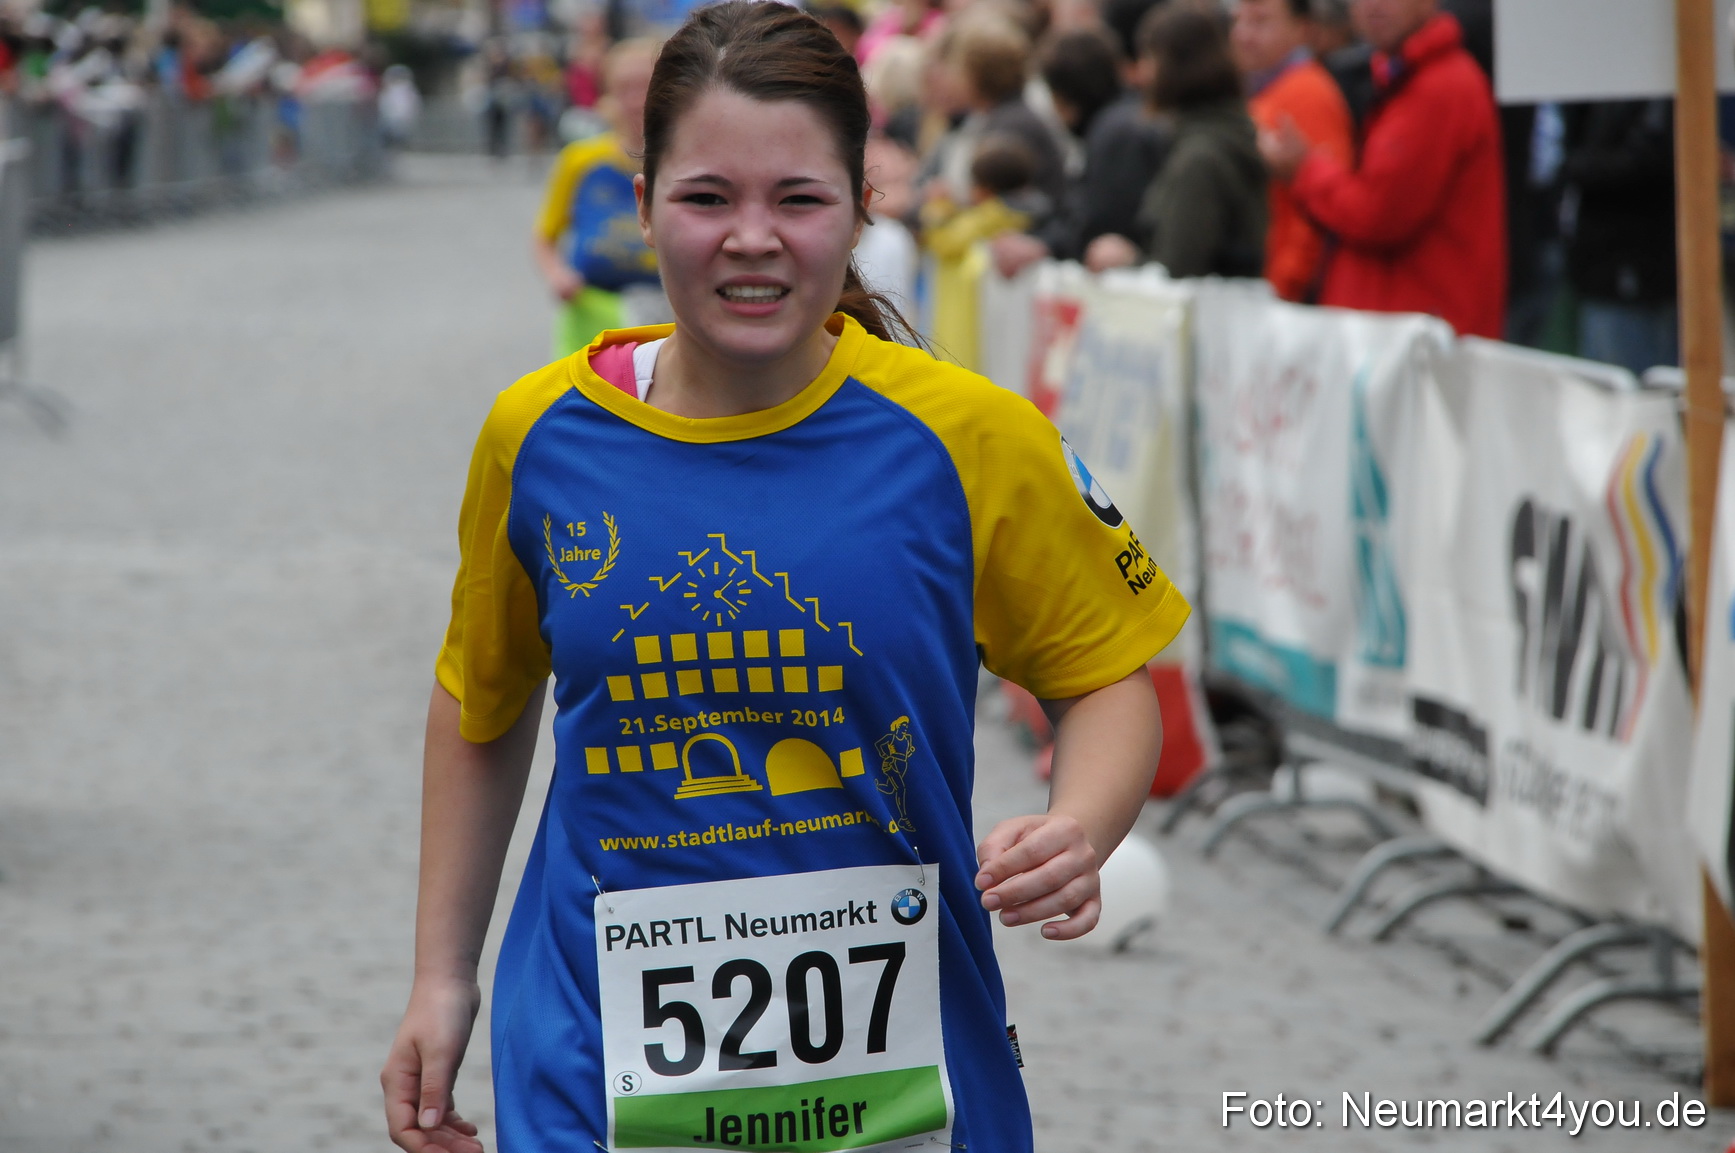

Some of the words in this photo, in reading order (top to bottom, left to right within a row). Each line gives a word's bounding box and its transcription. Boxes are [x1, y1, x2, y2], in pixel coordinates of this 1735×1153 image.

[566, 521, 586, 536] 15
[559, 545, 601, 562] Jahre
[618, 706, 784, 734] 21.September
[790, 706, 845, 727] 2014
[604, 916, 717, 952] PARTL
[724, 900, 878, 941] Neumarkt
[641, 941, 906, 1077] 5207
[621, 1074, 634, 1092] S
[693, 1096, 867, 1146] Jennifer
